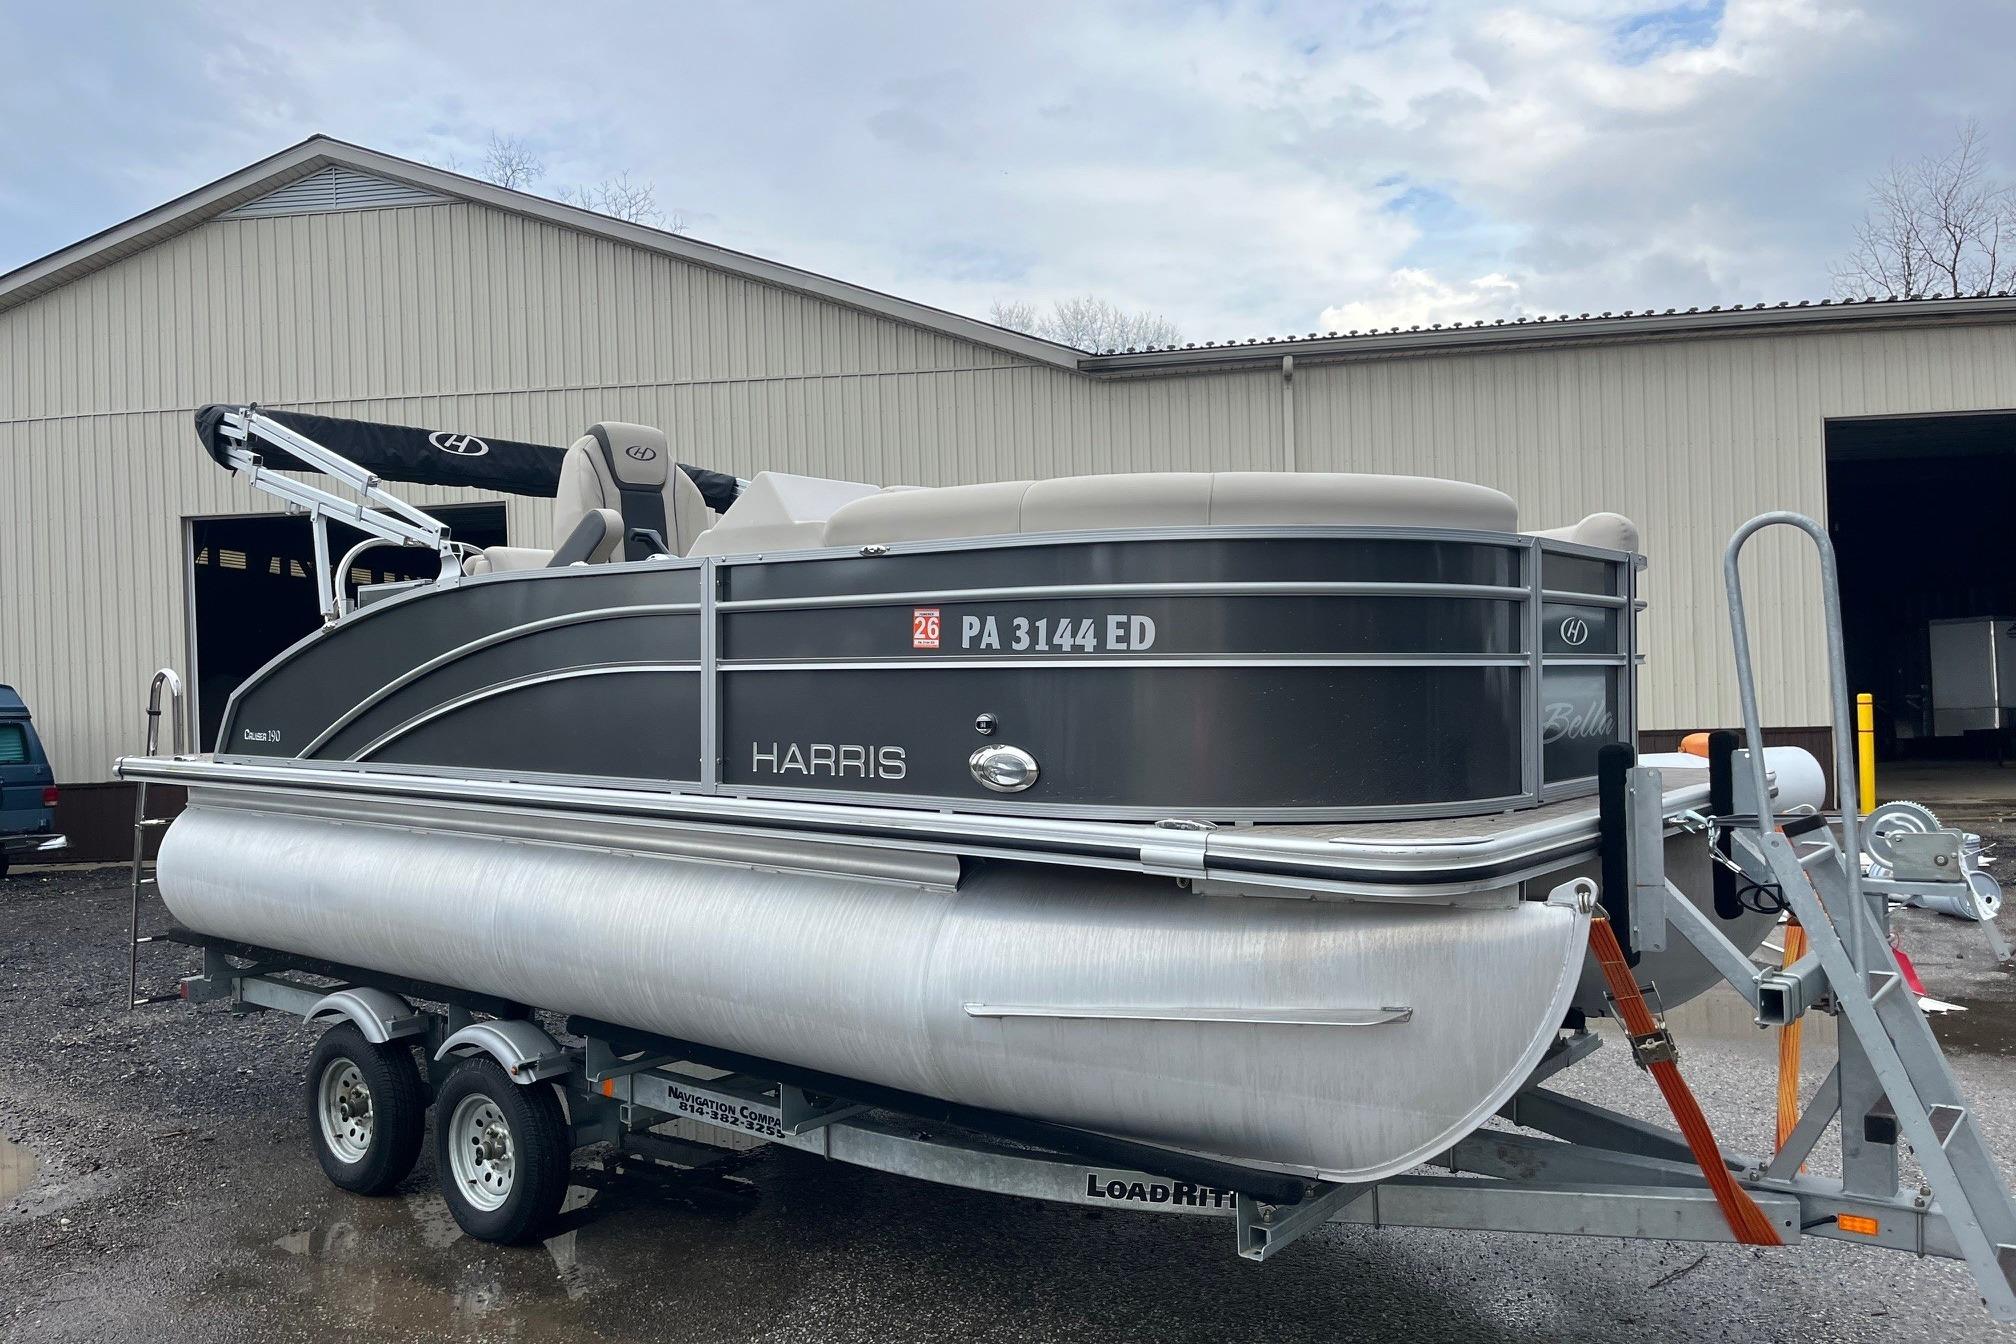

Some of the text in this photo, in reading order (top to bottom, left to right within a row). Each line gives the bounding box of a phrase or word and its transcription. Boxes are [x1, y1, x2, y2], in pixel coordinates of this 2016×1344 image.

[914, 616, 939, 639] 26
[962, 614, 1156, 651] PA 3144 ED
[268, 730, 281, 742] 190
[752, 741, 907, 779] HARRIS
[668, 1085, 783, 1128] NAVIGATION COMPA
[679, 1101, 786, 1138] 814-382-3255
